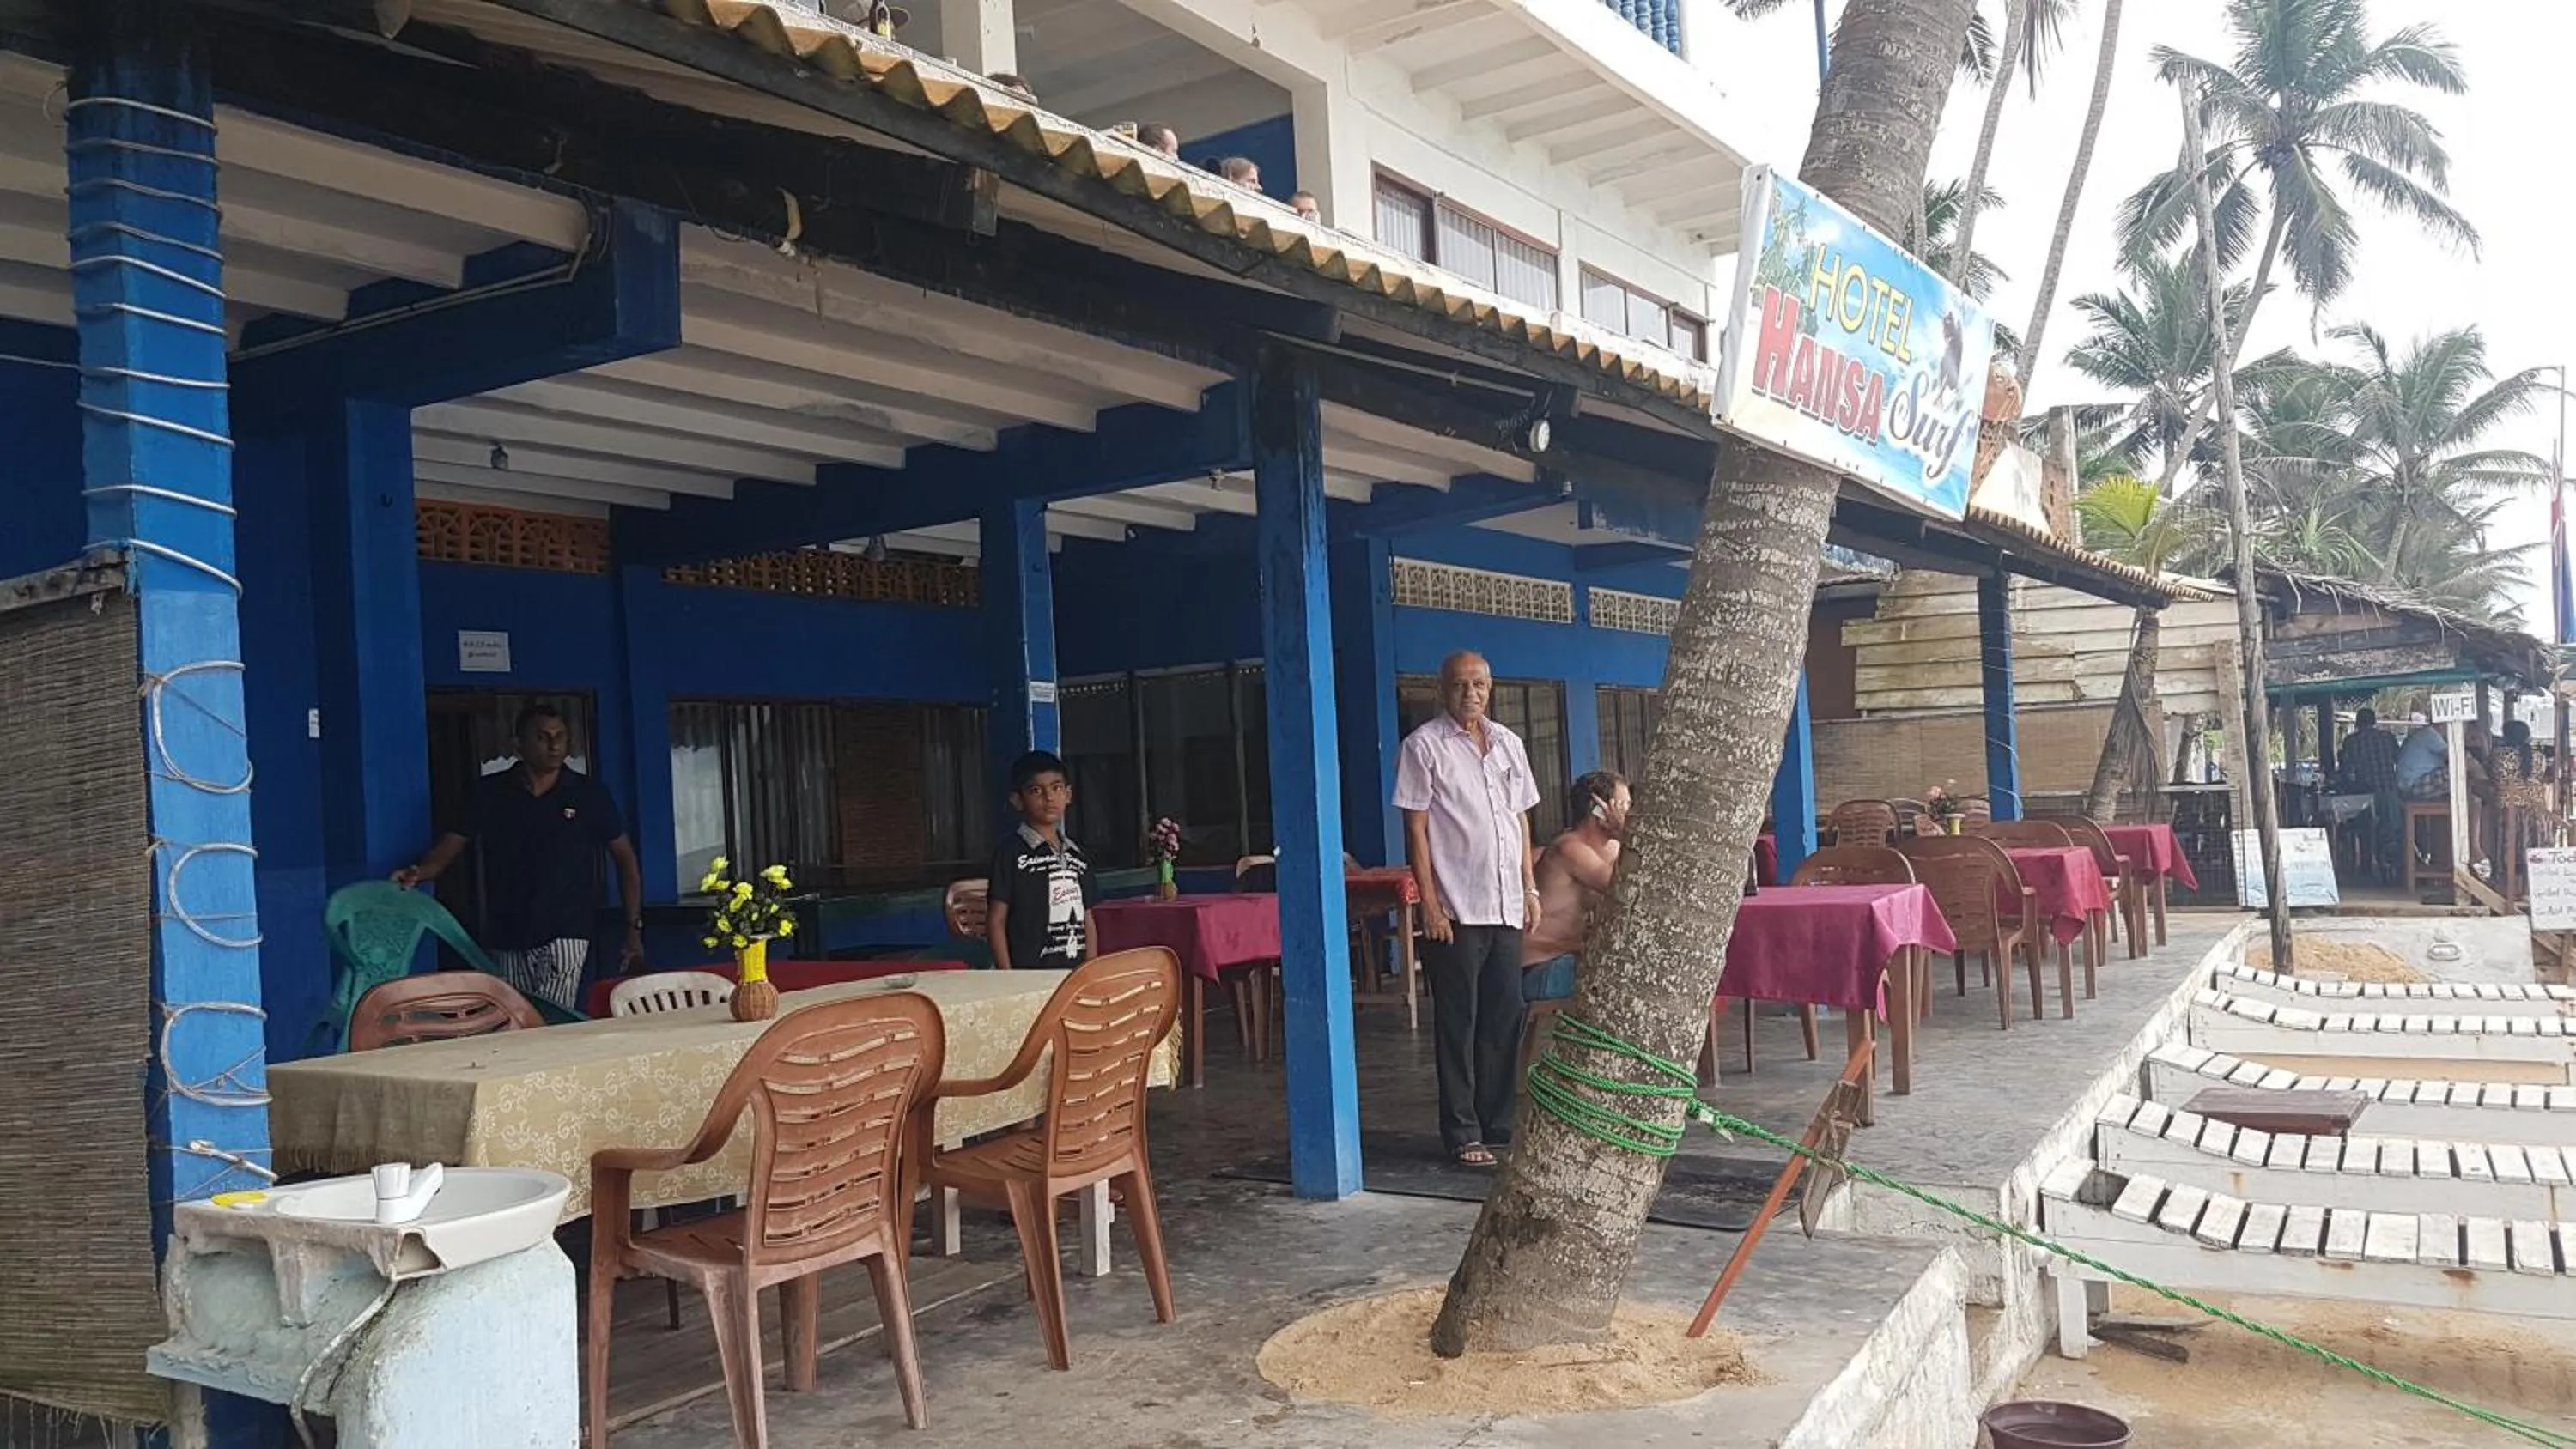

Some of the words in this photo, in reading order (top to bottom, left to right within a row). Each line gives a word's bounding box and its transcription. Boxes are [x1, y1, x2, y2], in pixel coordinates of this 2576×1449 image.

[1807, 243, 1914, 365] HOTEL
[1752, 283, 1885, 447] HANSA
[1889, 371, 1974, 479] Surf
[2433, 696, 2476, 717] Wi-Fi
